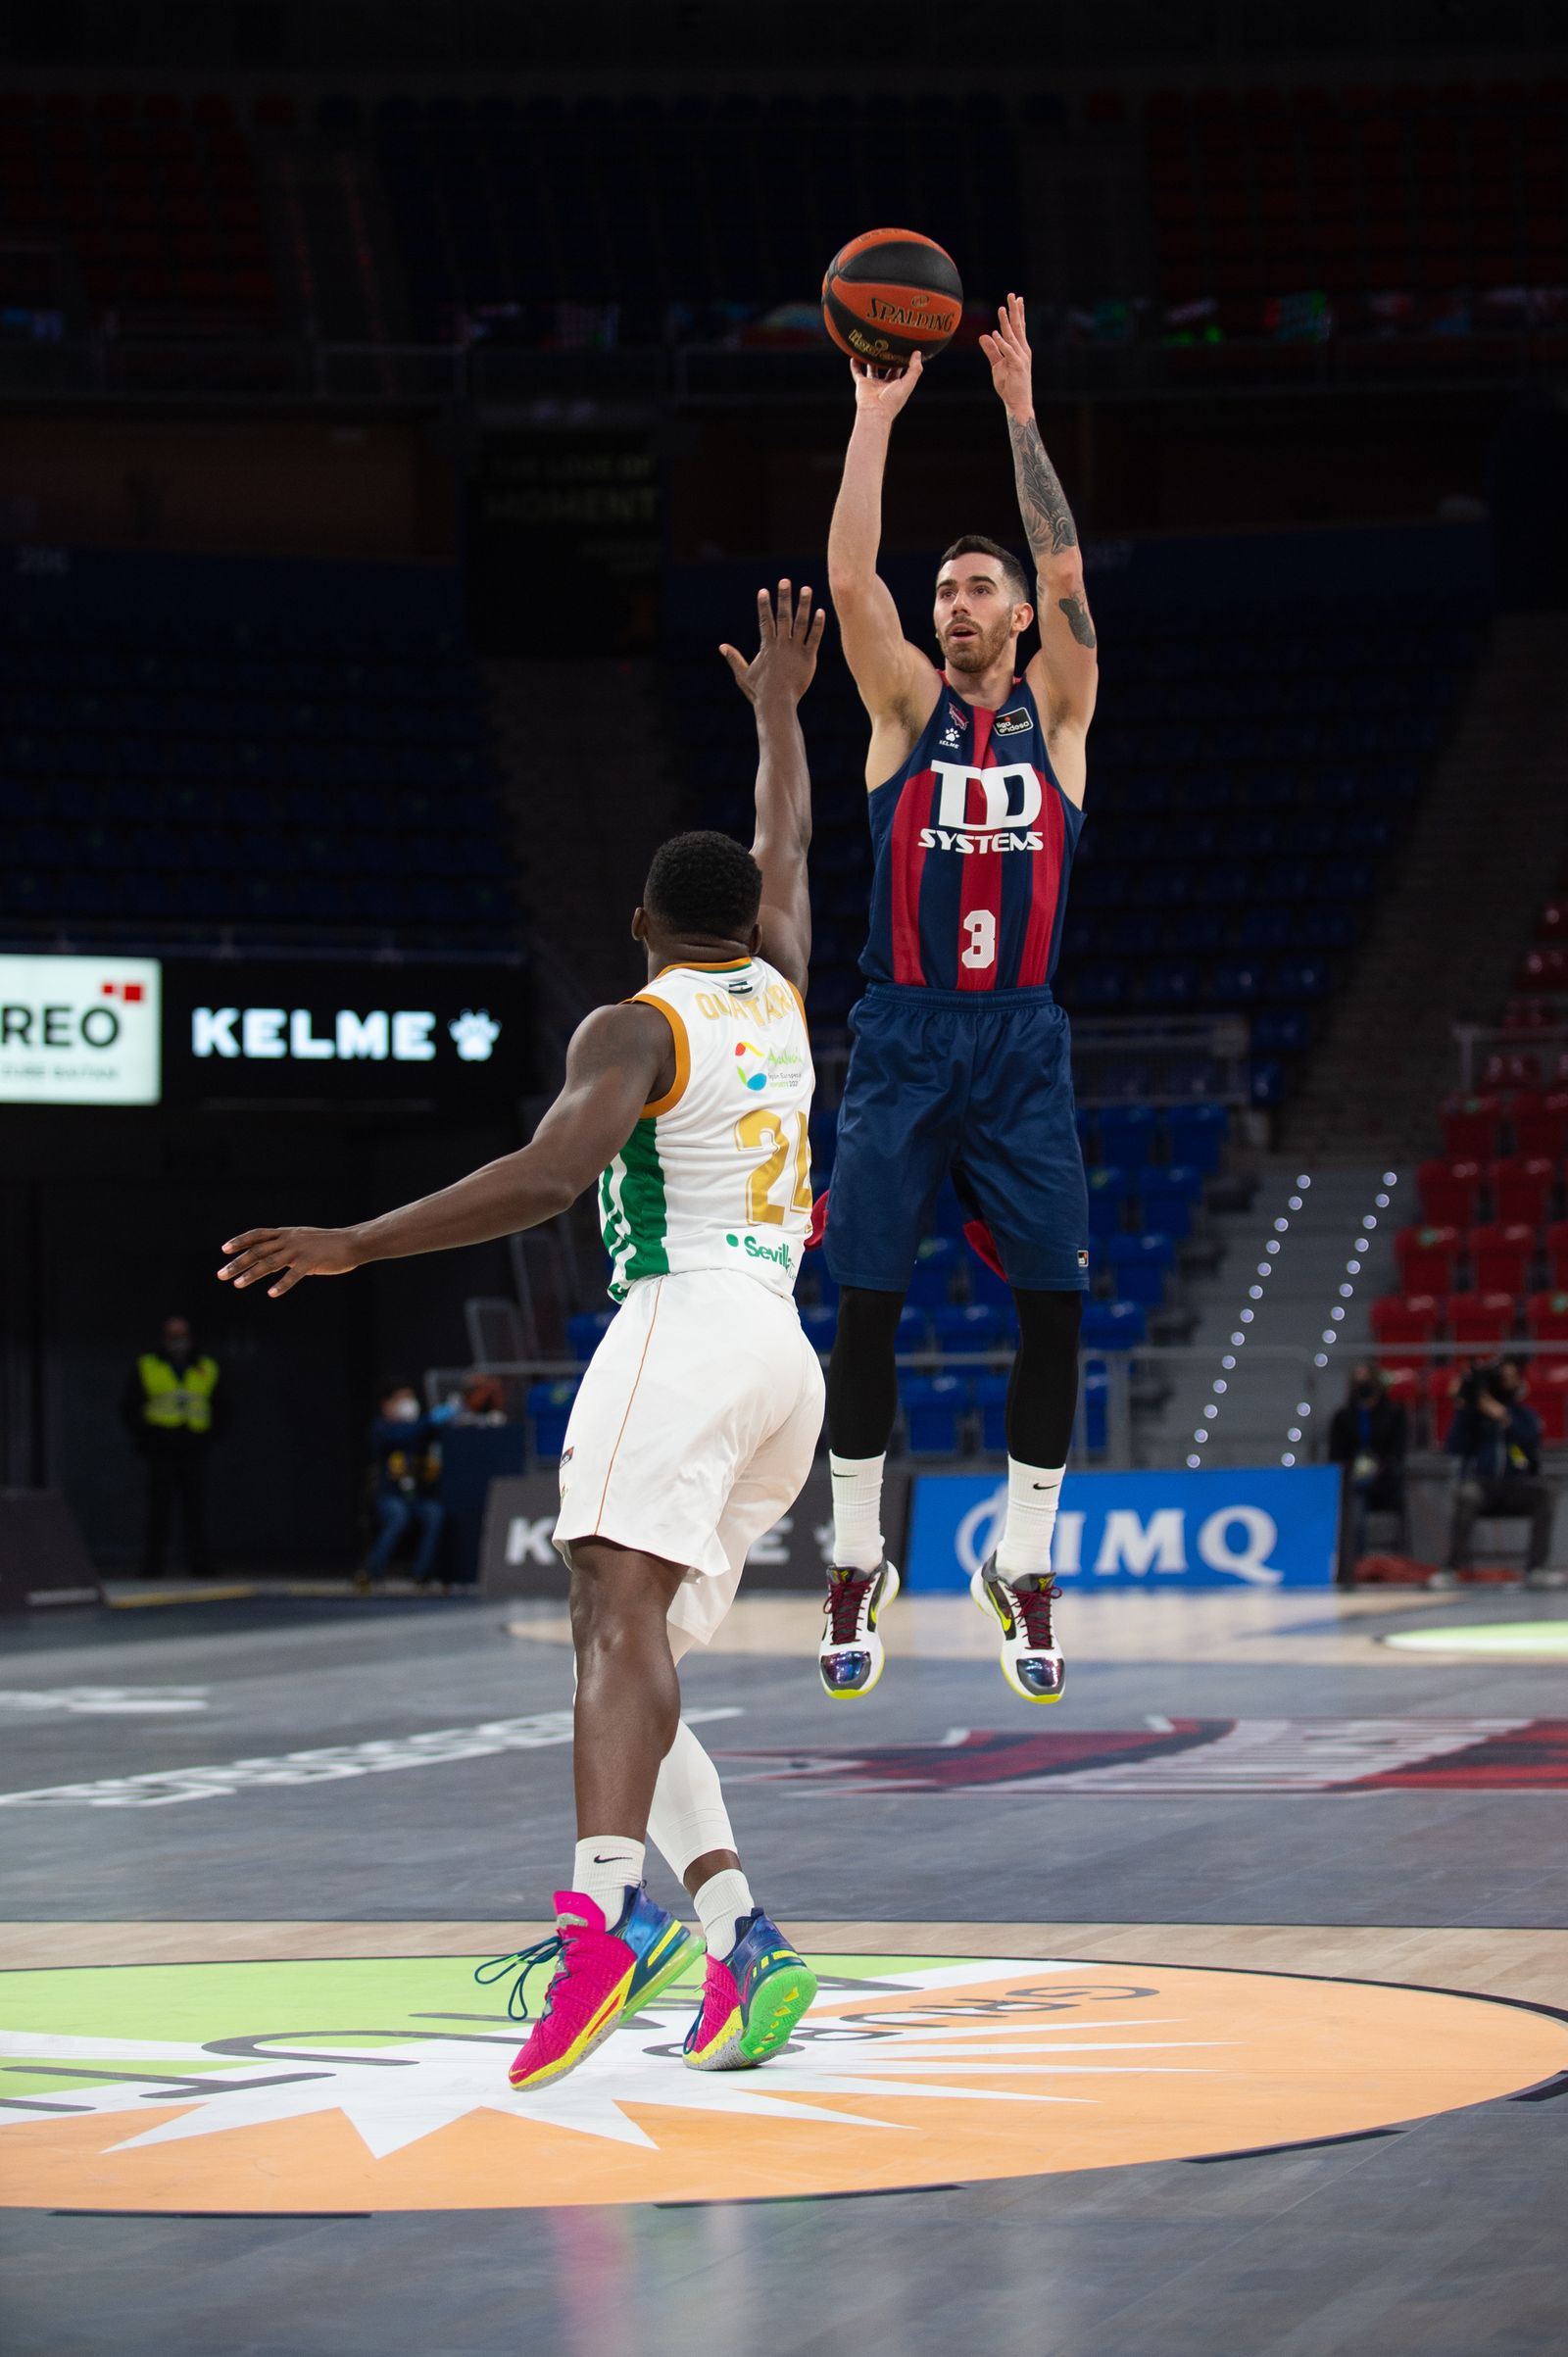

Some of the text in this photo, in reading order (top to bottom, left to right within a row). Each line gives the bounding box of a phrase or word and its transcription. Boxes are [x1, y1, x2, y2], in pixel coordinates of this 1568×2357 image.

[866, 297, 956, 333] SPALDING
[930, 759, 1043, 831] TD
[917, 827, 1045, 855] SYSTEMS
[961, 908, 997, 969] 3
[0, 1006, 121, 1049] REO
[192, 1006, 437, 1061] KELME
[744, 1235, 792, 1270] Sevill
[1053, 1504, 1284, 1585] IMQ
